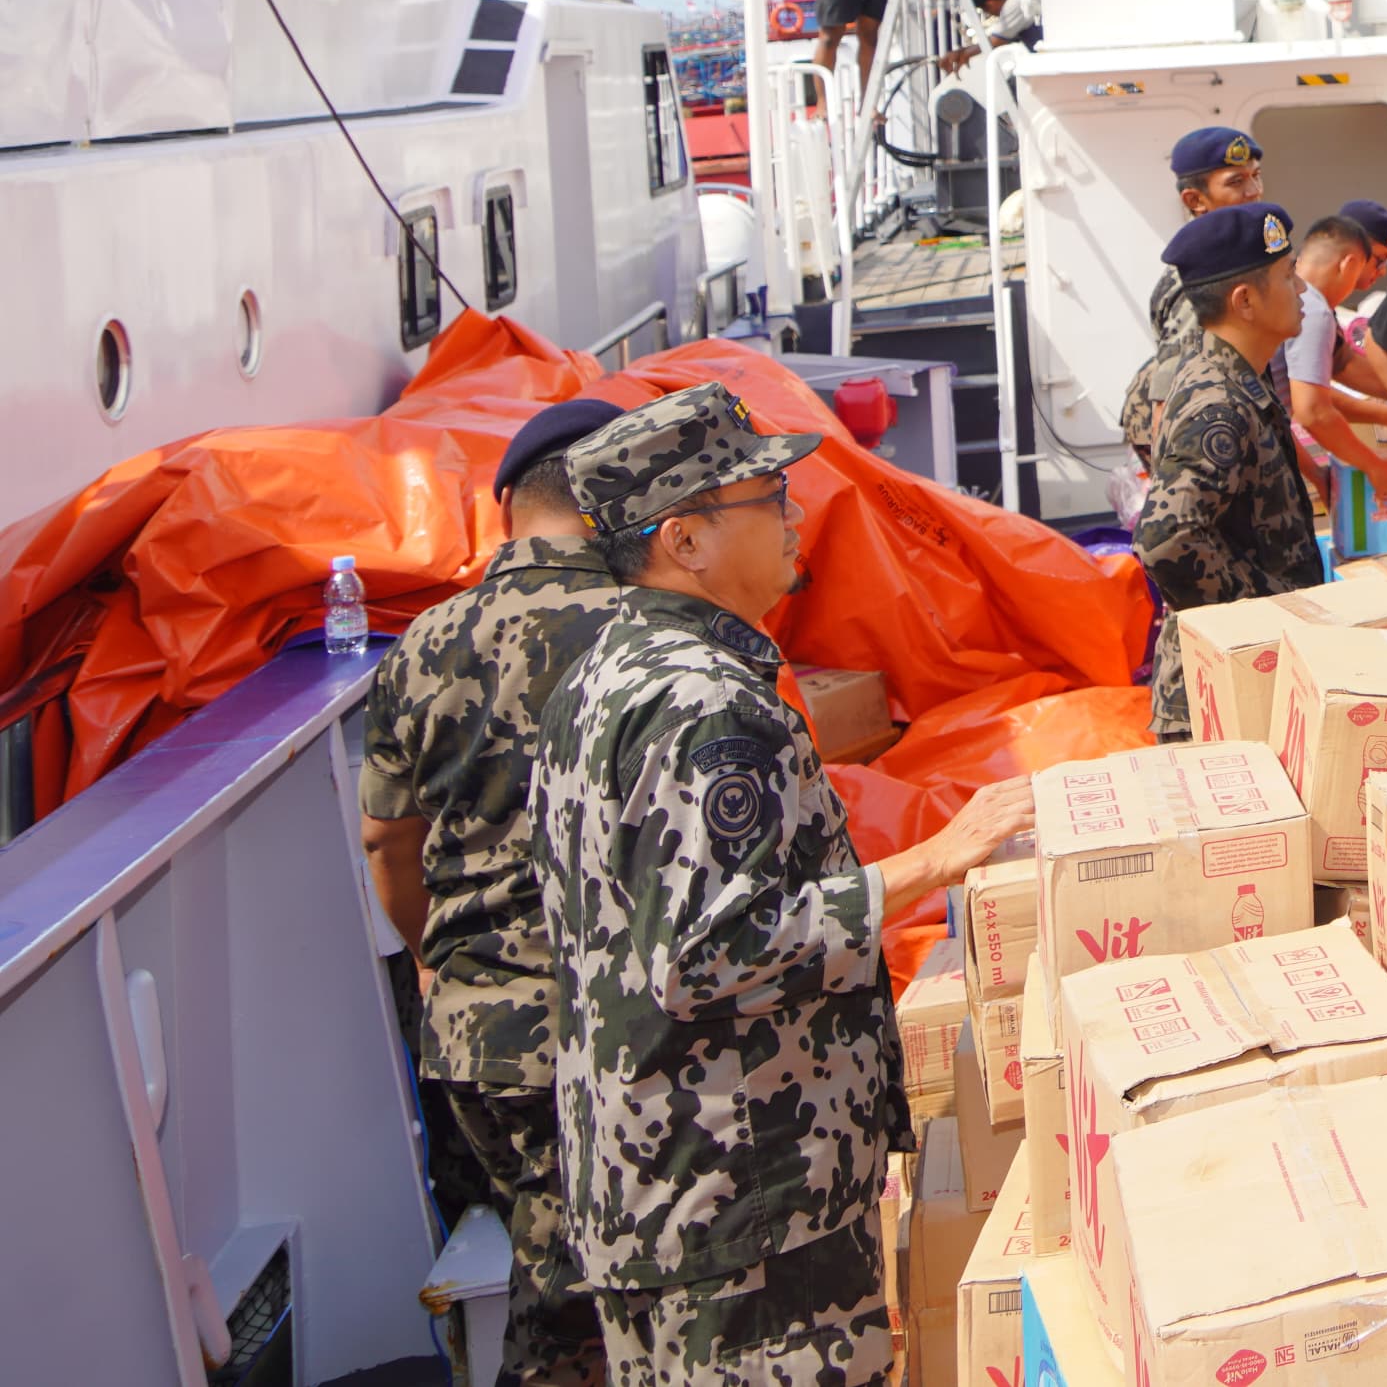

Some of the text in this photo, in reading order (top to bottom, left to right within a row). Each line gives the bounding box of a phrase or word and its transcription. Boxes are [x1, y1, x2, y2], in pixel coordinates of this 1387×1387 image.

[983, 900, 997, 920] 24
[988, 933, 1002, 962] 550
[1075, 916, 1152, 963] Vit
[991, 967, 1006, 986] ml
[1307, 1339, 1341, 1357] HALAL
